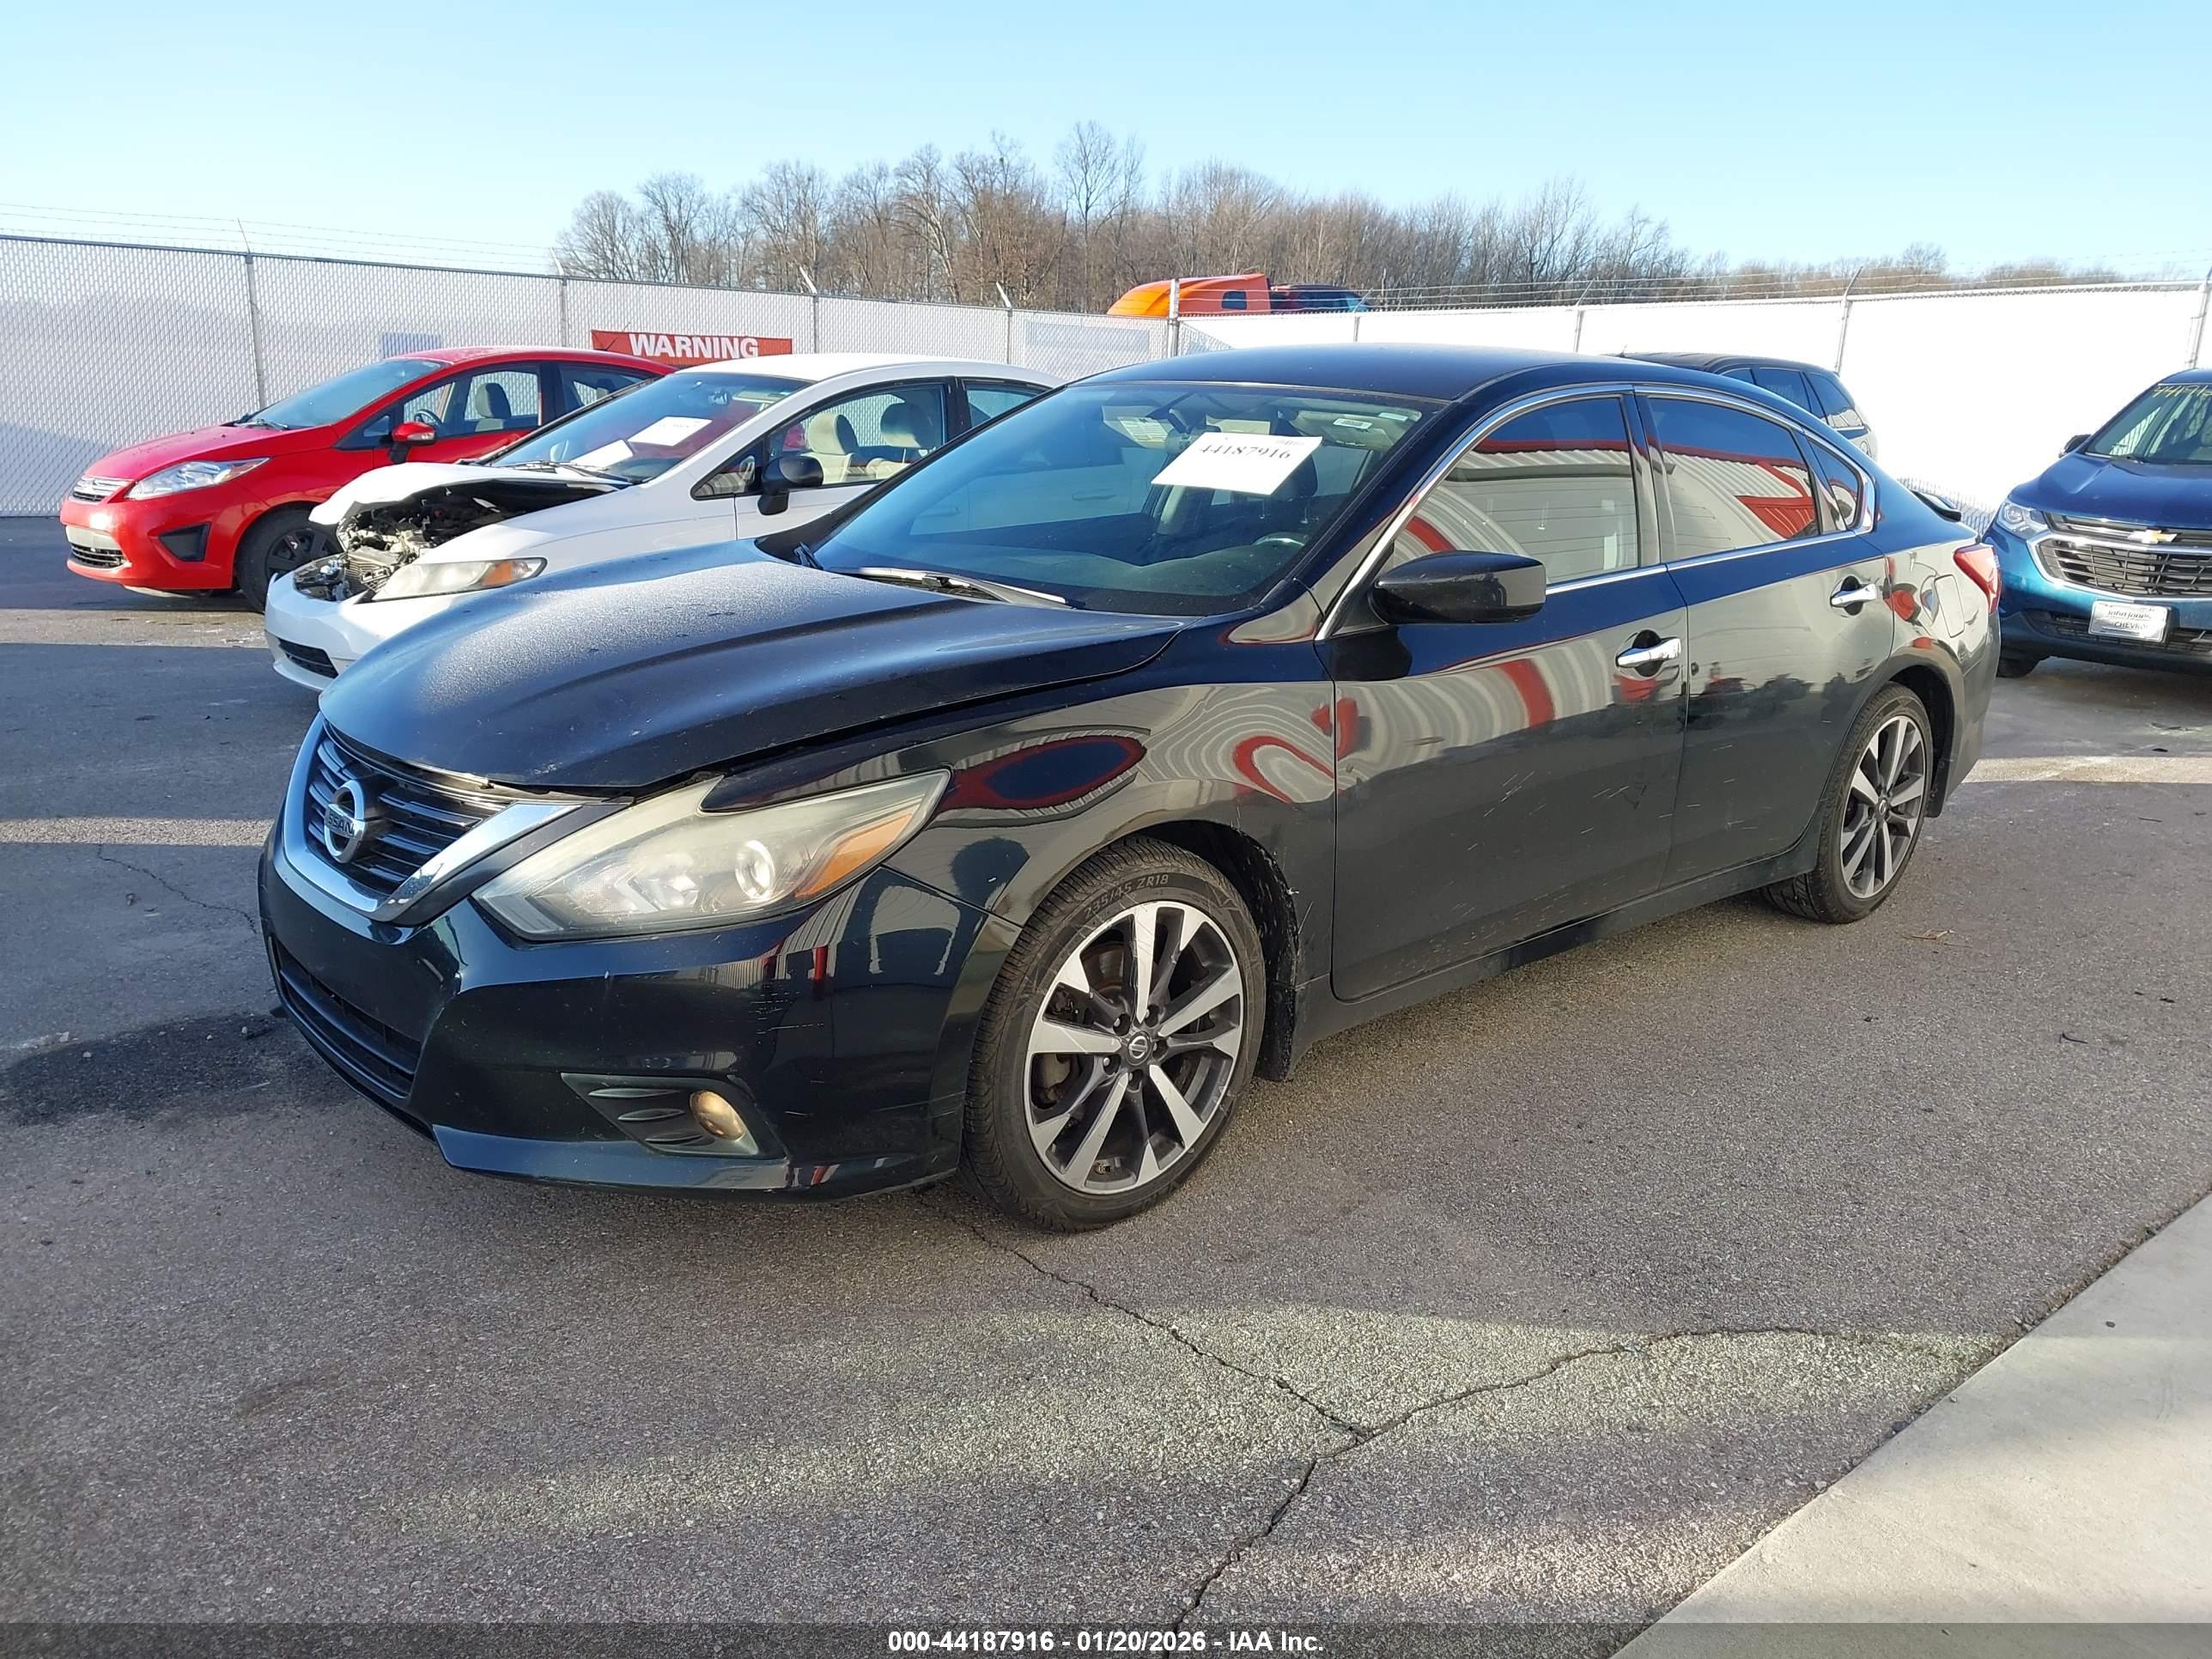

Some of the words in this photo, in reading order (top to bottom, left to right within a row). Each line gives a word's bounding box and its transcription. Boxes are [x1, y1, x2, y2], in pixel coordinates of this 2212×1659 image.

[629, 333, 758, 359] WARNING
[1199, 445, 1291, 459] 44187916
[1085, 881, 1133, 918] 235/45
[1137, 874, 1169, 890] ZR18
